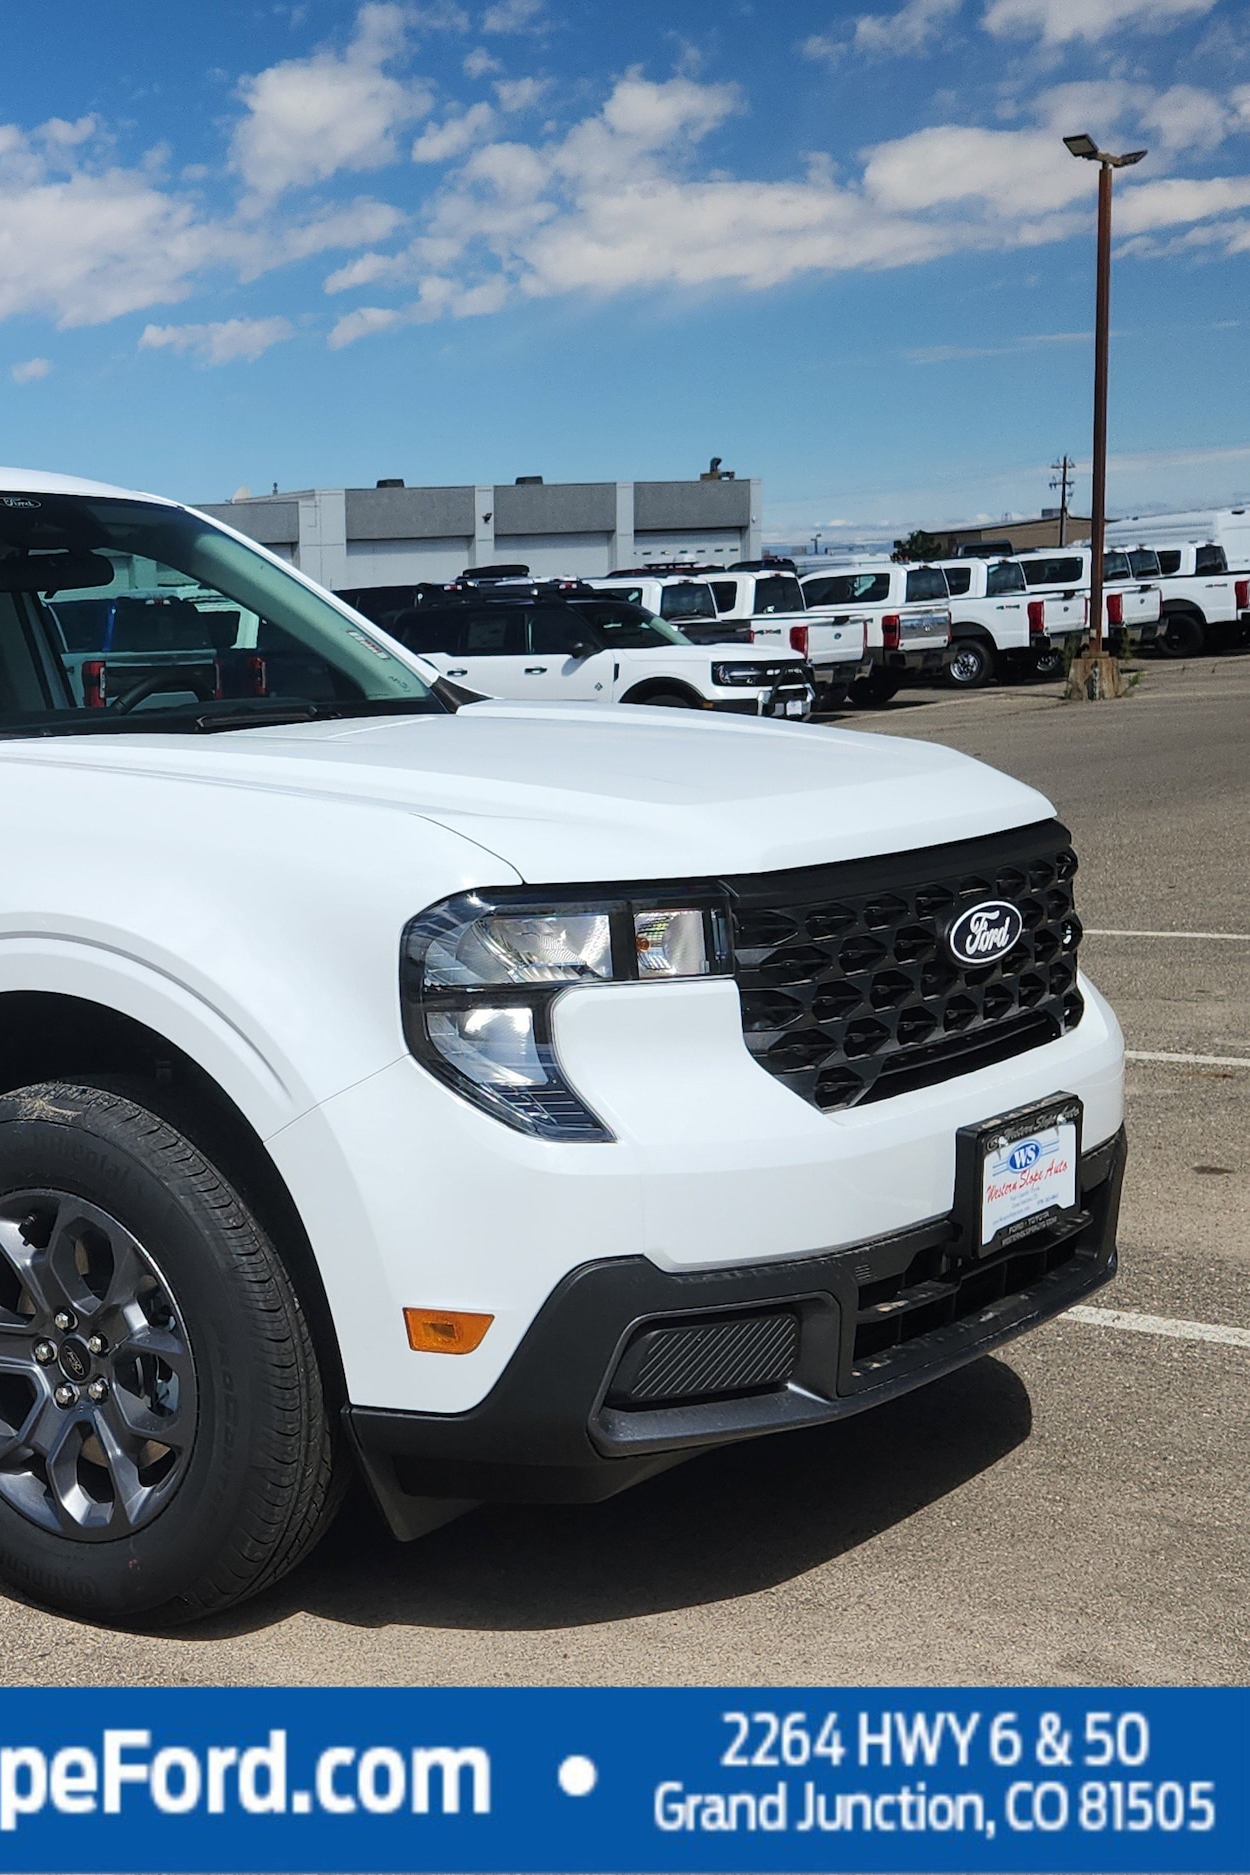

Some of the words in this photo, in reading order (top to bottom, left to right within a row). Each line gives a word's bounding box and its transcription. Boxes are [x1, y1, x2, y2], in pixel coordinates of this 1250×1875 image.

[965, 910, 1011, 955] Ford
[1013, 1144, 1037, 1170] WS
[986, 1181, 1018, 1204] Western
[1019, 1168, 1043, 1188] Slope
[1044, 1158, 1068, 1180] Auto
